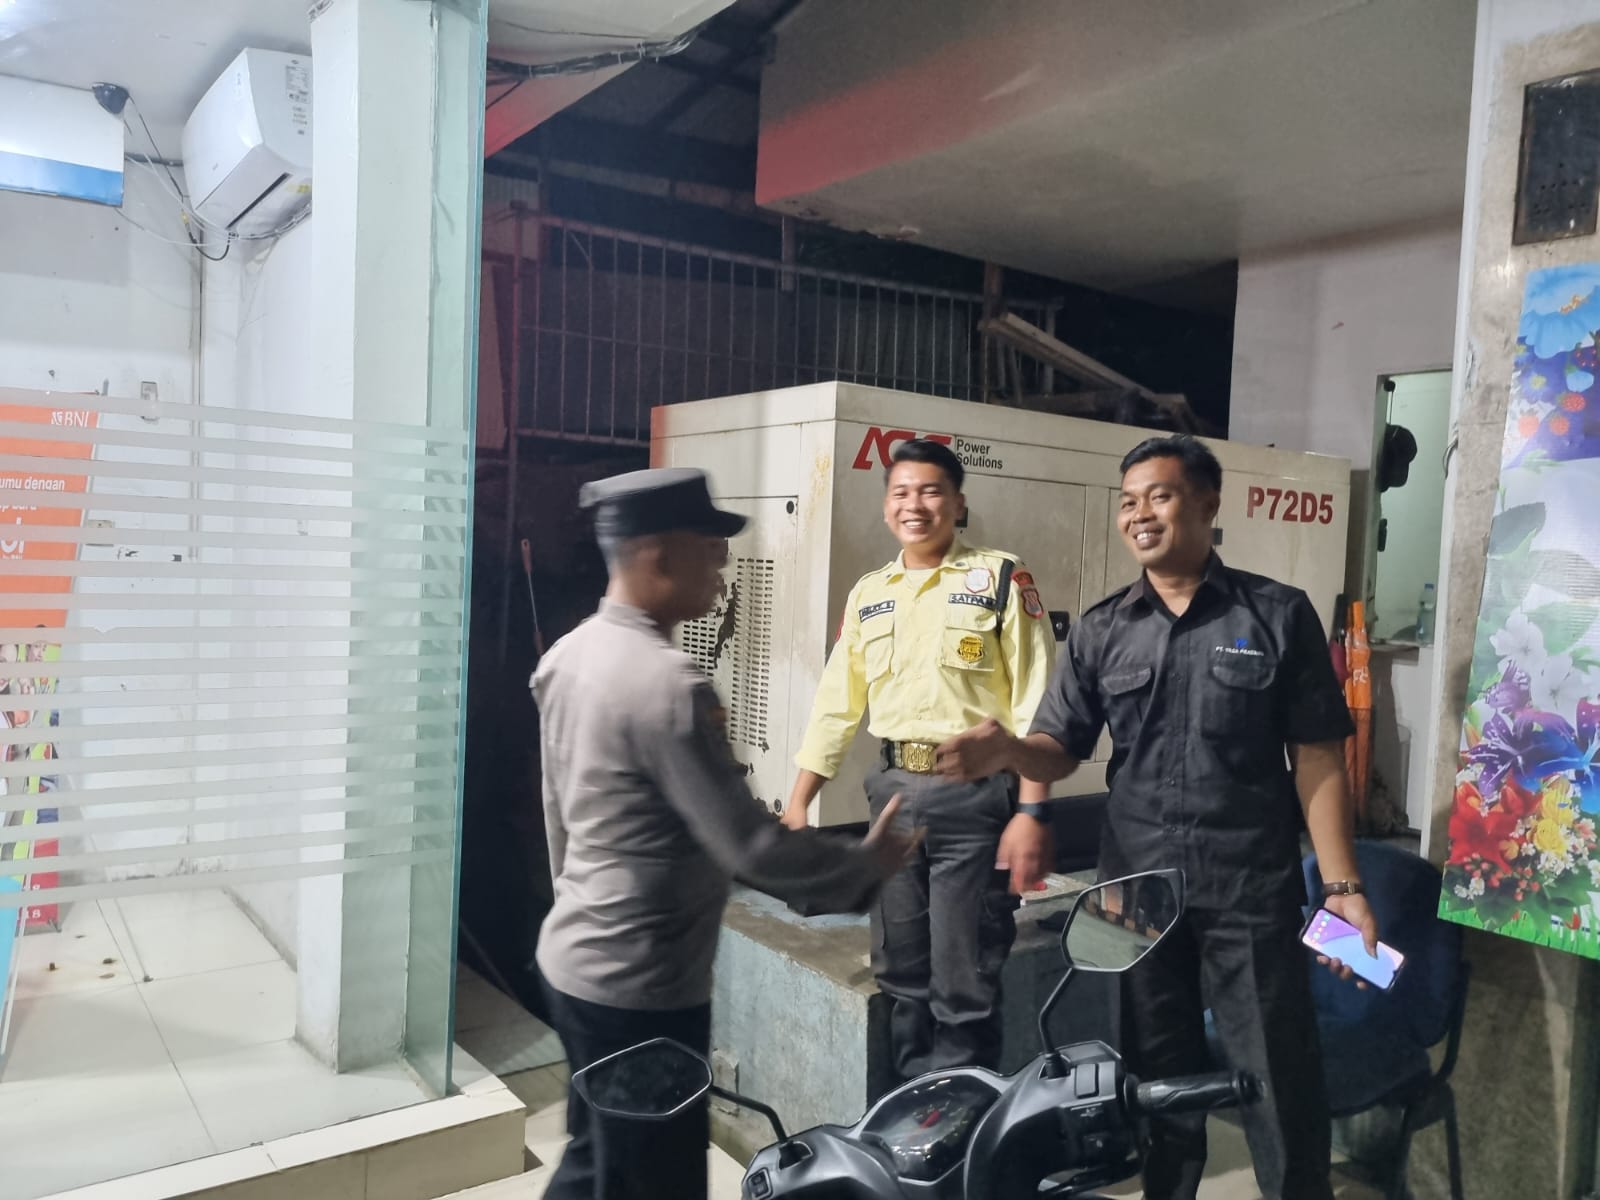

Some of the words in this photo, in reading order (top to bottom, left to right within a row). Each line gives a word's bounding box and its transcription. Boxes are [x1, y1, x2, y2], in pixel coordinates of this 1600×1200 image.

[64, 411, 89, 428] BNI
[956, 438, 991, 455] Power
[956, 453, 1004, 470] Solutions
[1246, 485, 1334, 525] P72D5
